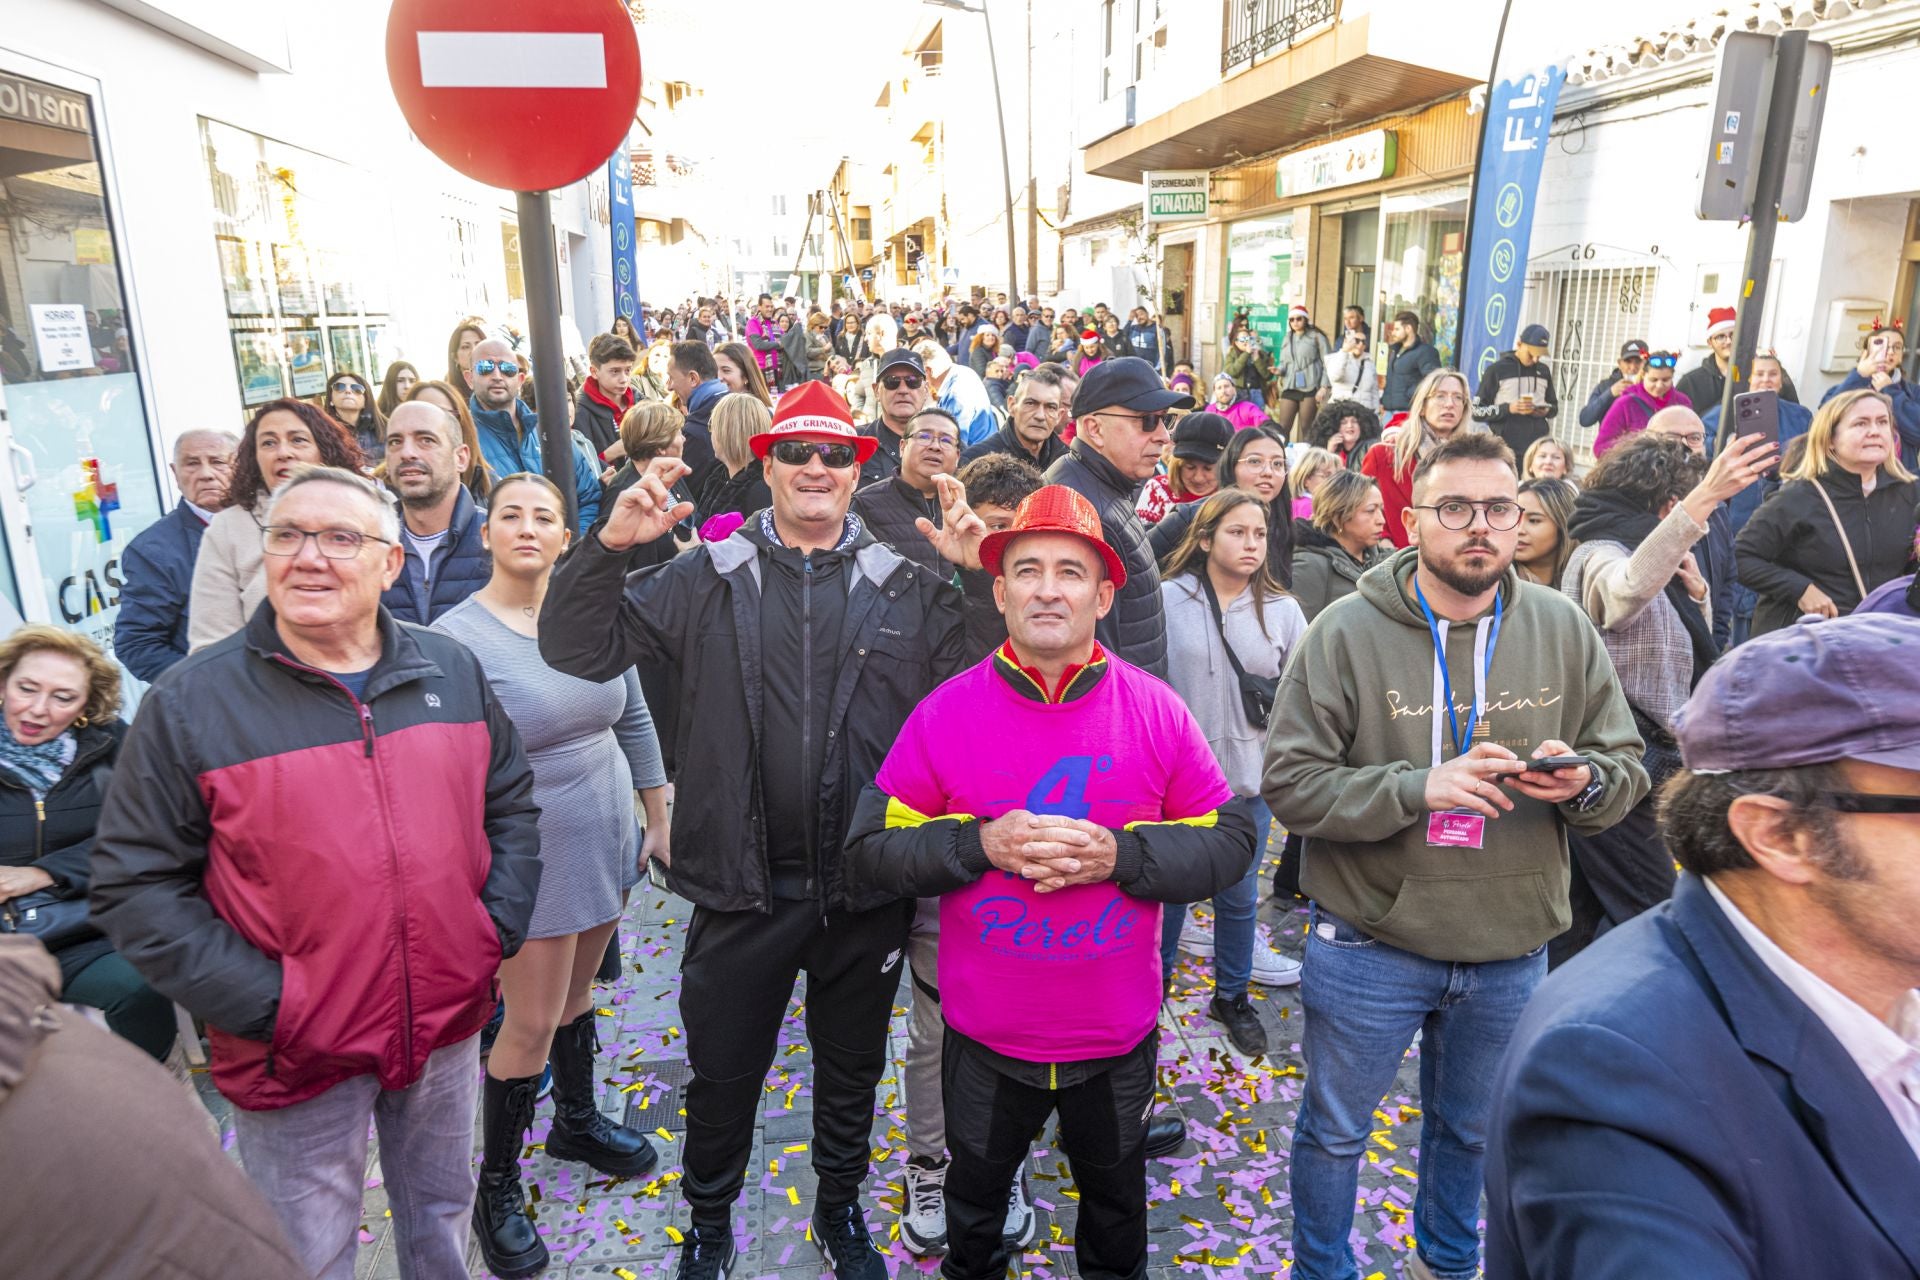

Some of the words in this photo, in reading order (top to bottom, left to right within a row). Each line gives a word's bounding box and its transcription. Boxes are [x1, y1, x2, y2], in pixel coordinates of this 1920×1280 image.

[1151, 178, 1196, 188] SUPERMERCADO
[1152, 193, 1204, 213] PINATAR
[803, 419, 842, 431] GRIMASY
